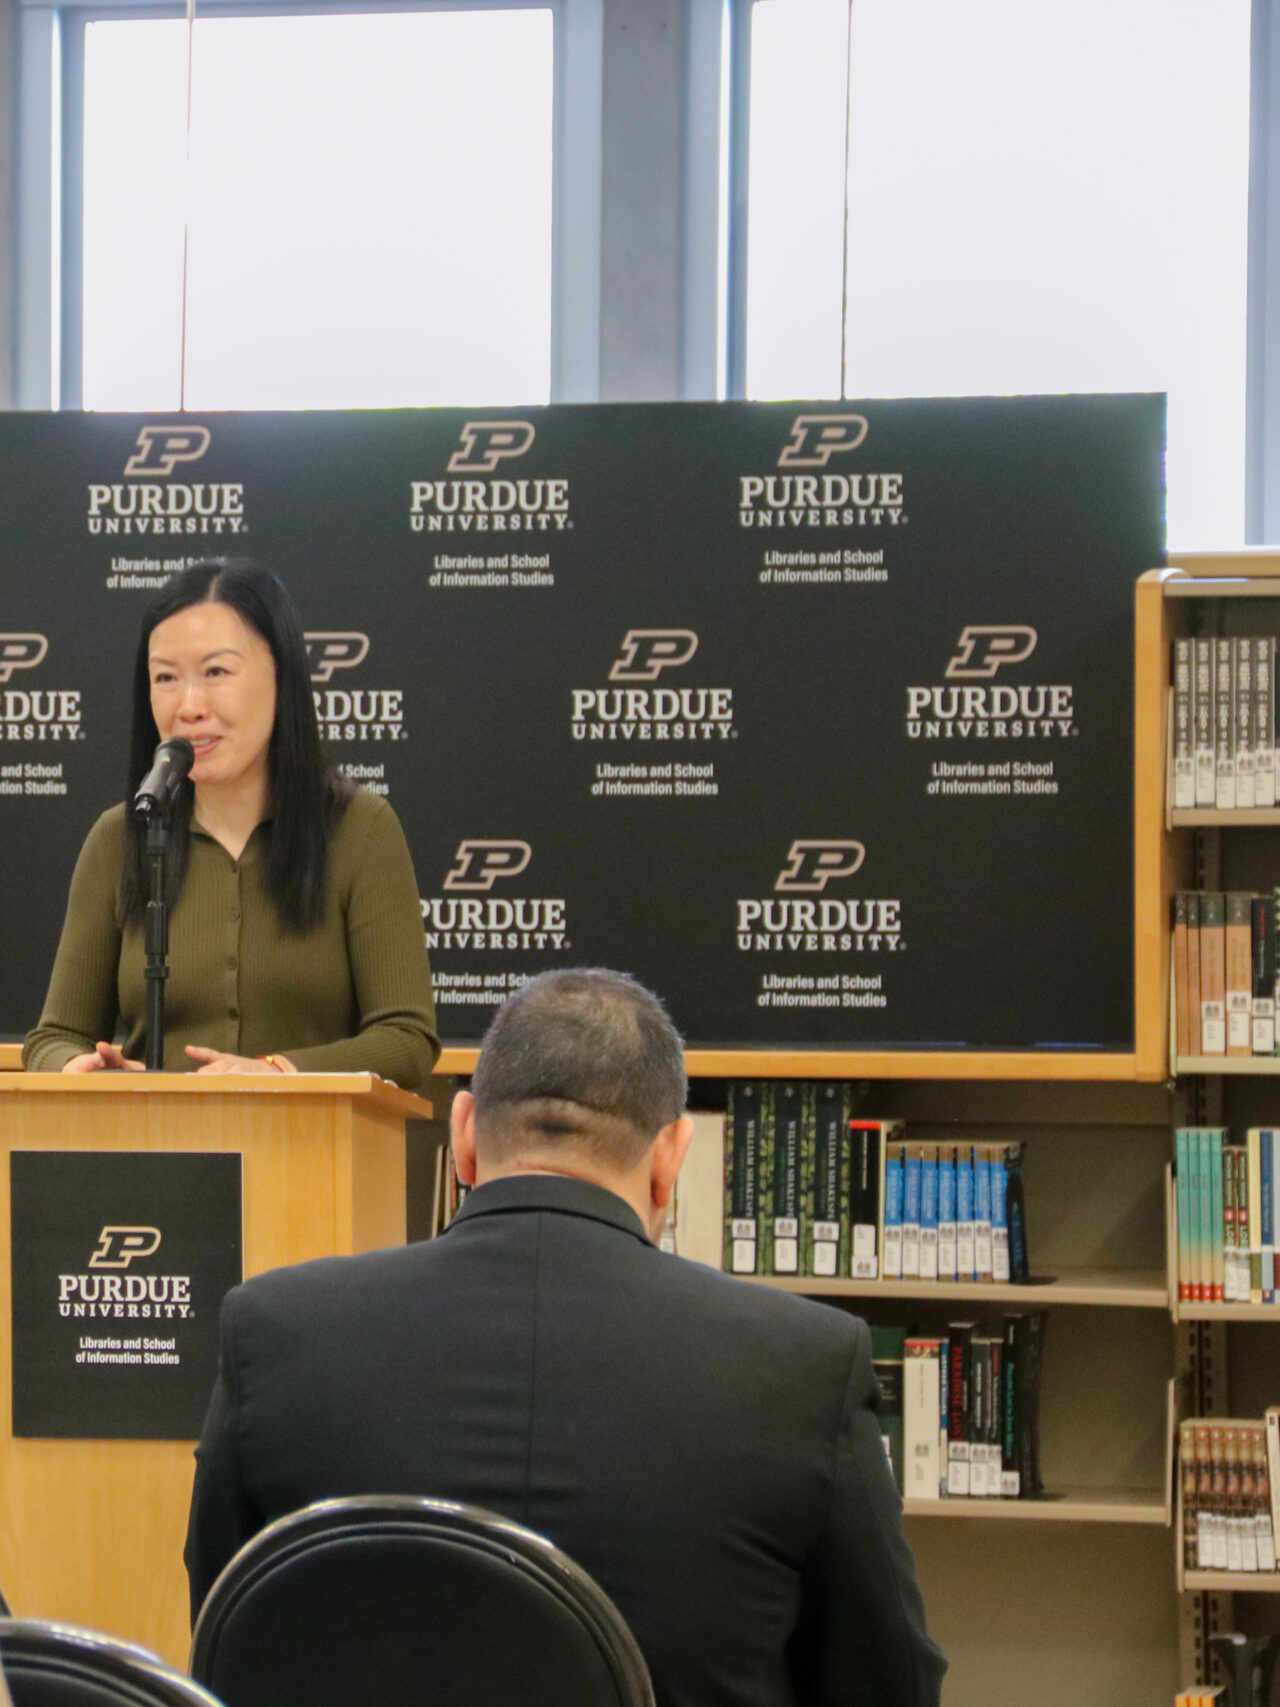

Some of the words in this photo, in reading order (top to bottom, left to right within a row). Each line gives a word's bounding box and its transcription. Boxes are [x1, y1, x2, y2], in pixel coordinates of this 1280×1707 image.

[410, 480, 569, 512] PURDUE
[740, 473, 903, 506] PURDUE
[87, 483, 244, 516] PURDUE
[87, 517, 243, 534] UNIVERSITY
[410, 514, 568, 531] UNIVERSITY
[740, 508, 904, 526] UNIVERSITY
[111, 557, 161, 571] Libraries
[163, 557, 185, 571] and
[434, 553, 486, 569] Libraries
[486, 553, 510, 569] and
[510, 553, 550, 569] School
[764, 549, 818, 566] Libraries
[818, 549, 842, 566] and
[842, 549, 884, 566] School
[106, 574, 119, 588] of
[429, 571, 442, 587] of
[442, 571, 510, 587] Information
[510, 571, 555, 587] Studies
[759, 566, 773, 583] of
[773, 566, 842, 583] Information
[842, 566, 889, 583] Studies
[313, 690, 404, 722] RDUE
[571, 688, 733, 721] PURDUE
[907, 685, 1073, 719] PURDUE
[571, 722, 731, 740] UNIVERSITY
[907, 720, 1071, 738] UNIVERSITY
[1, 763, 23, 779] and
[23, 763, 63, 779] School
[345, 763, 385, 778] School
[596, 762, 649, 779] Libraries
[649, 762, 673, 779] and
[673, 762, 714, 779] School
[932, 761, 987, 777] Libraries
[987, 761, 1012, 777] and
[1012, 761, 1054, 777] School
[23, 779, 68, 795] Studies
[591, 780, 605, 796] of
[604, 780, 673, 796] Information
[673, 780, 719, 796] Studies
[926, 778, 940, 795] of
[940, 778, 1011, 795] Information
[1011, 778, 1059, 795] Studies
[737, 899, 902, 932] PURDUE
[424, 932, 566, 950] NIVERSITY
[737, 933, 899, 951] UNIVERSITY
[431, 972, 482, 987] Libraries
[483, 972, 506, 987] and
[762, 973, 816, 990] Libraries
[816, 973, 840, 990] and
[840, 973, 882, 990] School
[441, 990, 507, 1005] Information
[757, 991, 771, 1008] of
[771, 991, 841, 1008] Information
[841, 991, 888, 1008] Studies
[746, 1120, 755, 1166] WILLIAM
[787, 1120, 796, 1166] WILLIAM
[828, 1121, 837, 1167] WILLIAM
[58, 1275, 191, 1303] PURDUE
[58, 1303, 189, 1318] UNIVERSITY
[79, 1336, 123, 1351] Libraries
[123, 1336, 142, 1351] and
[142, 1336, 176, 1351] School
[75, 1351, 86, 1366] of
[86, 1351, 142, 1366] Information
[142, 1351, 180, 1366] Studies
